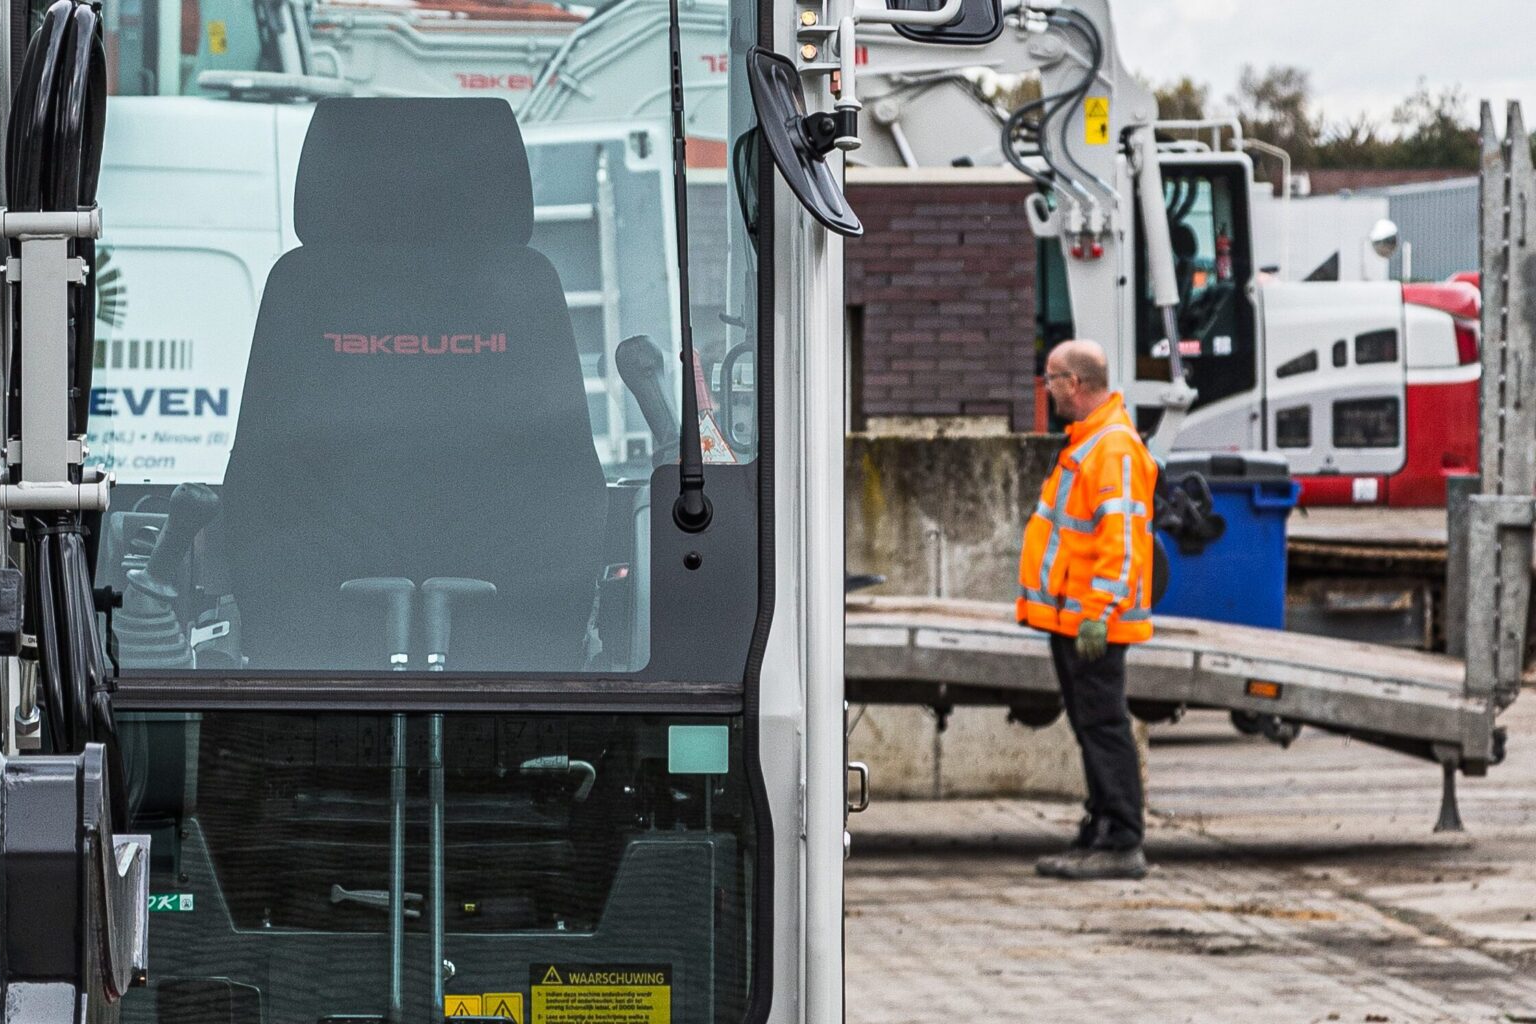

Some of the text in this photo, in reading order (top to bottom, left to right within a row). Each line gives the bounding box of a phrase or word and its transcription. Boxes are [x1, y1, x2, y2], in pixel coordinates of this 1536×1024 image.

[323, 332, 507, 354] TAKEUCHI
[89, 388, 229, 416] EVEN
[568, 972, 665, 984] WAARSCHUWING
